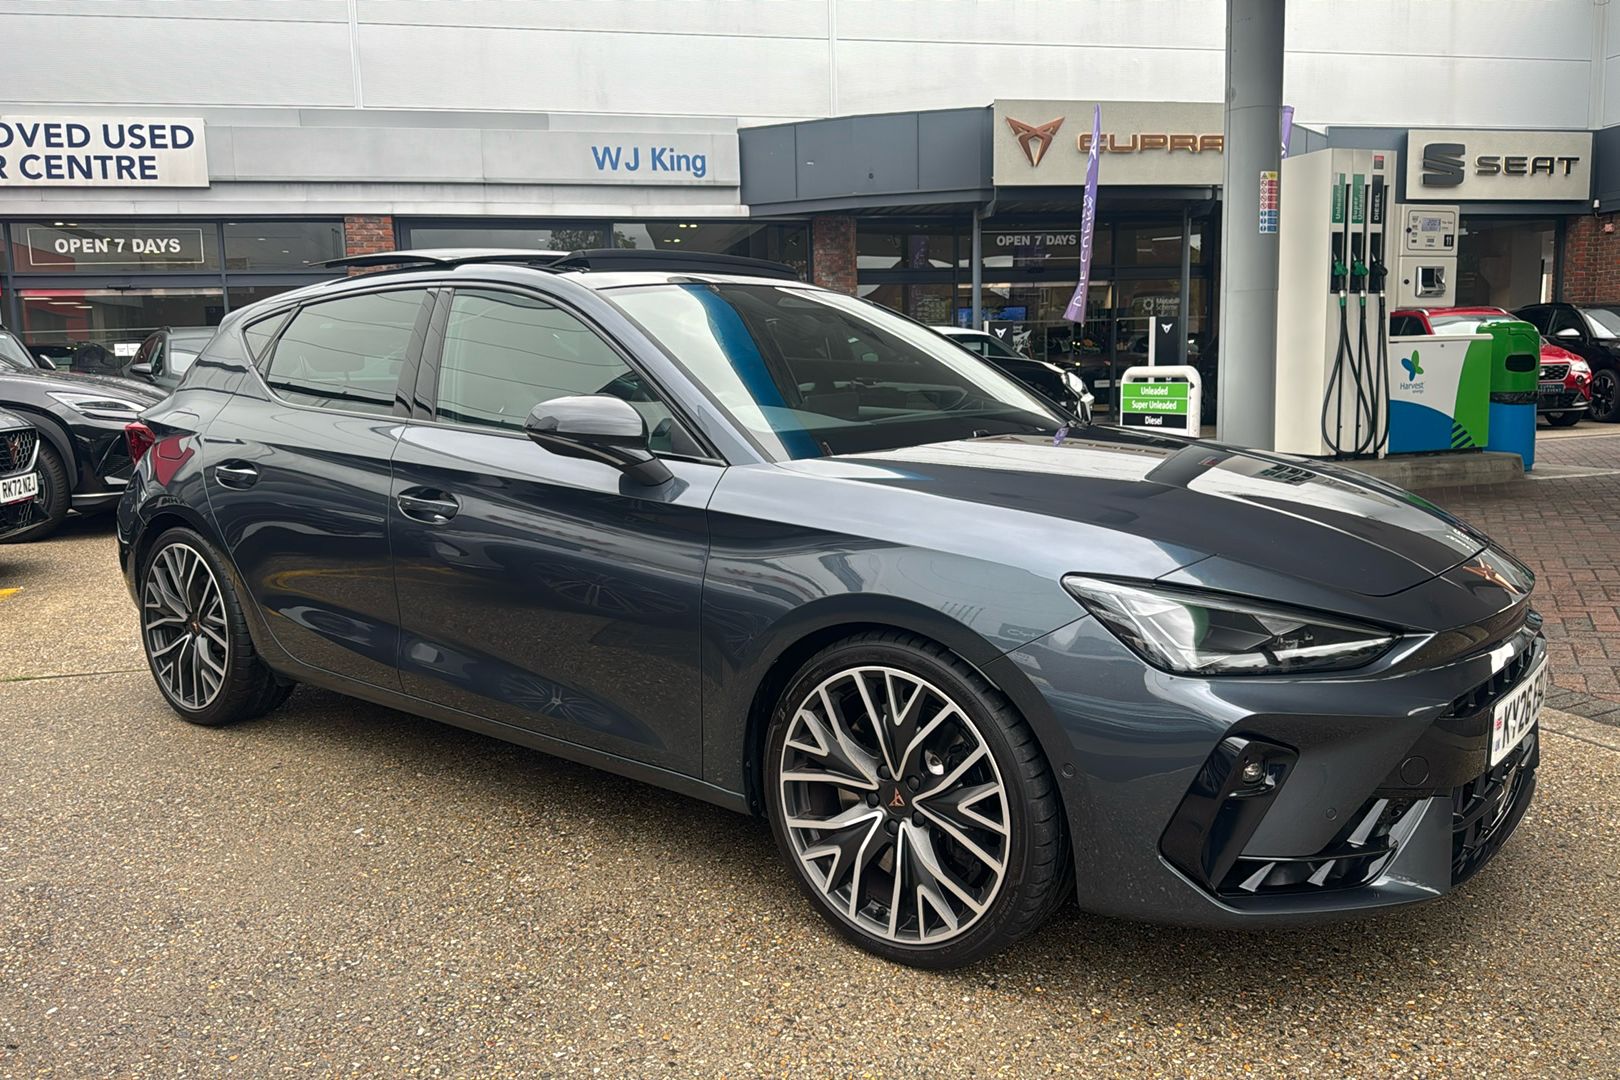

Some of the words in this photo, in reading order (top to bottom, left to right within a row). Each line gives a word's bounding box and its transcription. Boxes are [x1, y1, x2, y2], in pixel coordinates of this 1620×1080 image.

[102, 124, 194, 149] USED
[1079, 134, 1224, 152] CUPRA
[19, 154, 158, 180] CENTRE
[651, 147, 706, 178] King
[1475, 156, 1580, 177] SEAT
[1373, 192, 1381, 221] DIESEL
[54, 238, 108, 253] OPEN
[115, 239, 124, 252] 7
[132, 239, 181, 253] DAYS
[996, 235, 1031, 246] OPEN
[1034, 235, 1042, 245] 7
[1046, 234, 1077, 246] DAYS
[1140, 386, 1169, 396] Unleaded
[1131, 400, 1148, 411] Super
[1149, 401, 1177, 410] Unleaded
[1144, 416, 1163, 425] Diesel
[2, 479, 22, 499] RK72
